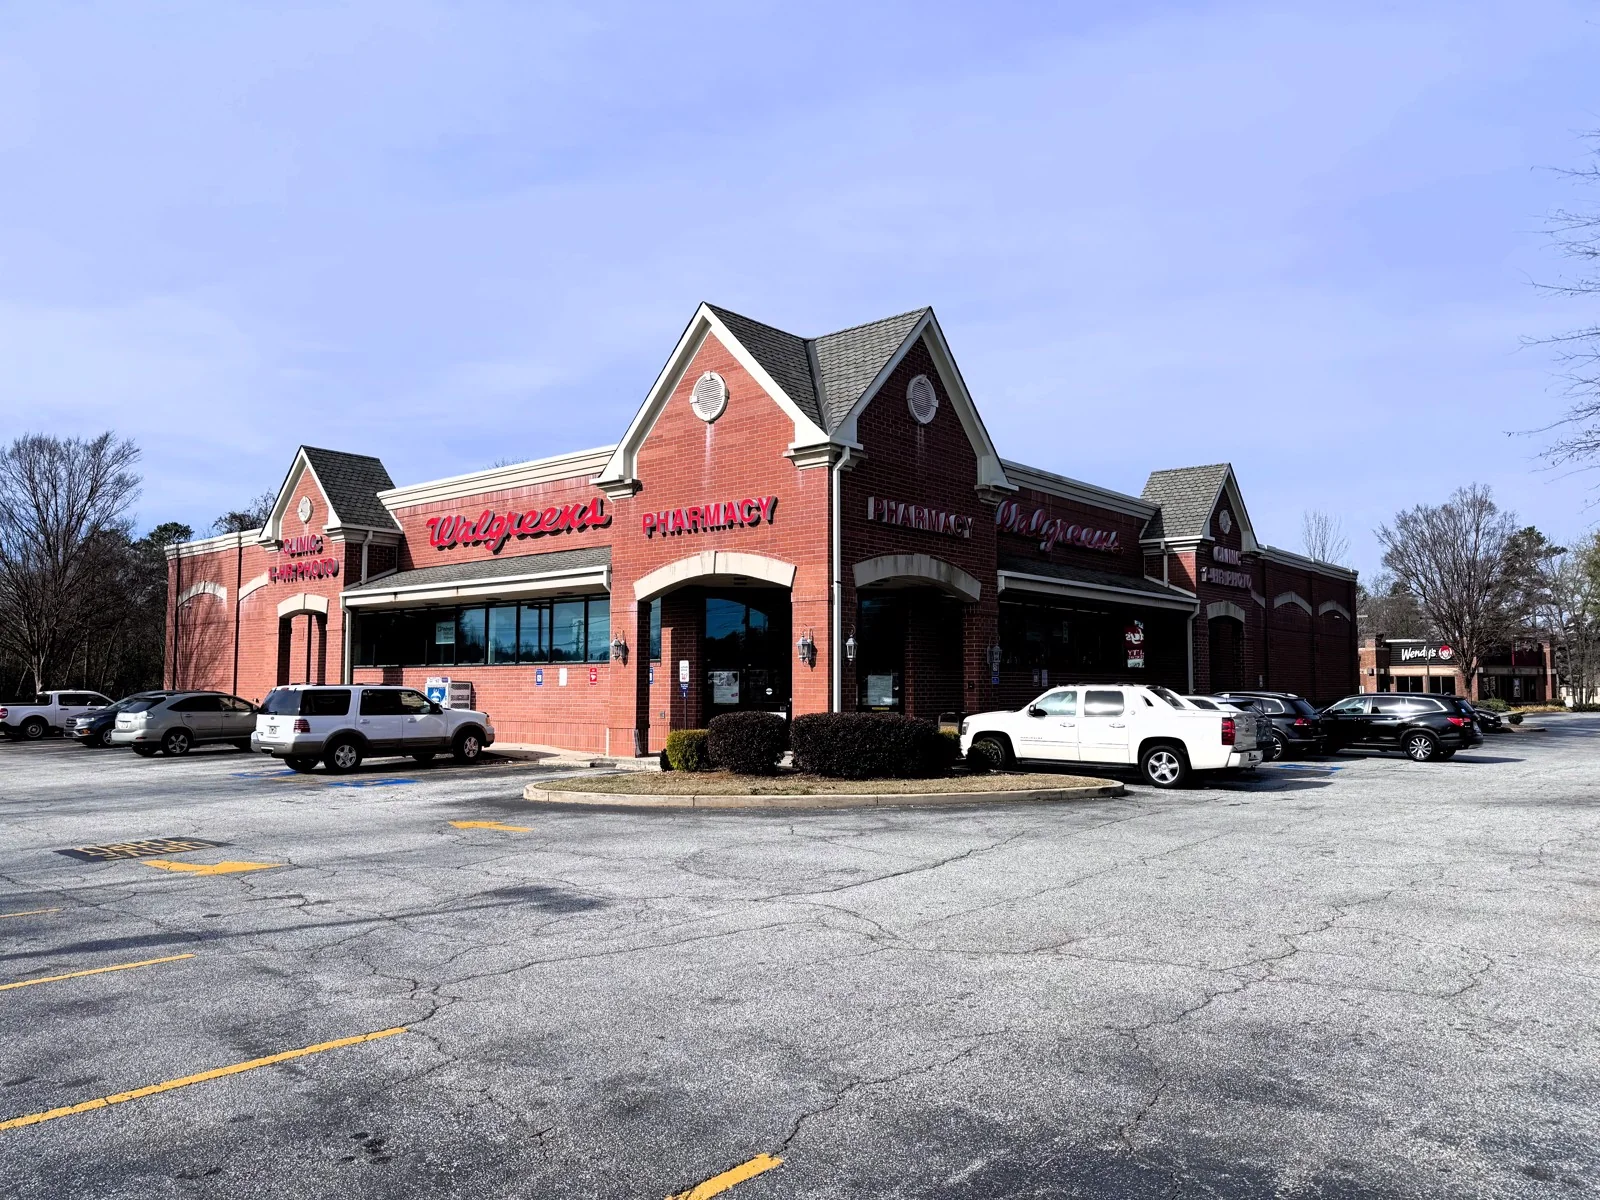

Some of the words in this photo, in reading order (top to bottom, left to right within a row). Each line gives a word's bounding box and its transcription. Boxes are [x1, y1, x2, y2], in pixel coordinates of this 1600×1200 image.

[426, 497, 609, 551] Walgreens
[641, 495, 775, 535] PHARMACY
[867, 496, 975, 538] PHARMACY
[995, 499, 1121, 552] Walgreens
[283, 534, 320, 555] CLINIC
[1213, 545, 1242, 567] CLINIC
[268, 563, 294, 582] 1-HR
[296, 558, 337, 578] PHOTO
[1401, 645, 1437, 661] Wendy's
